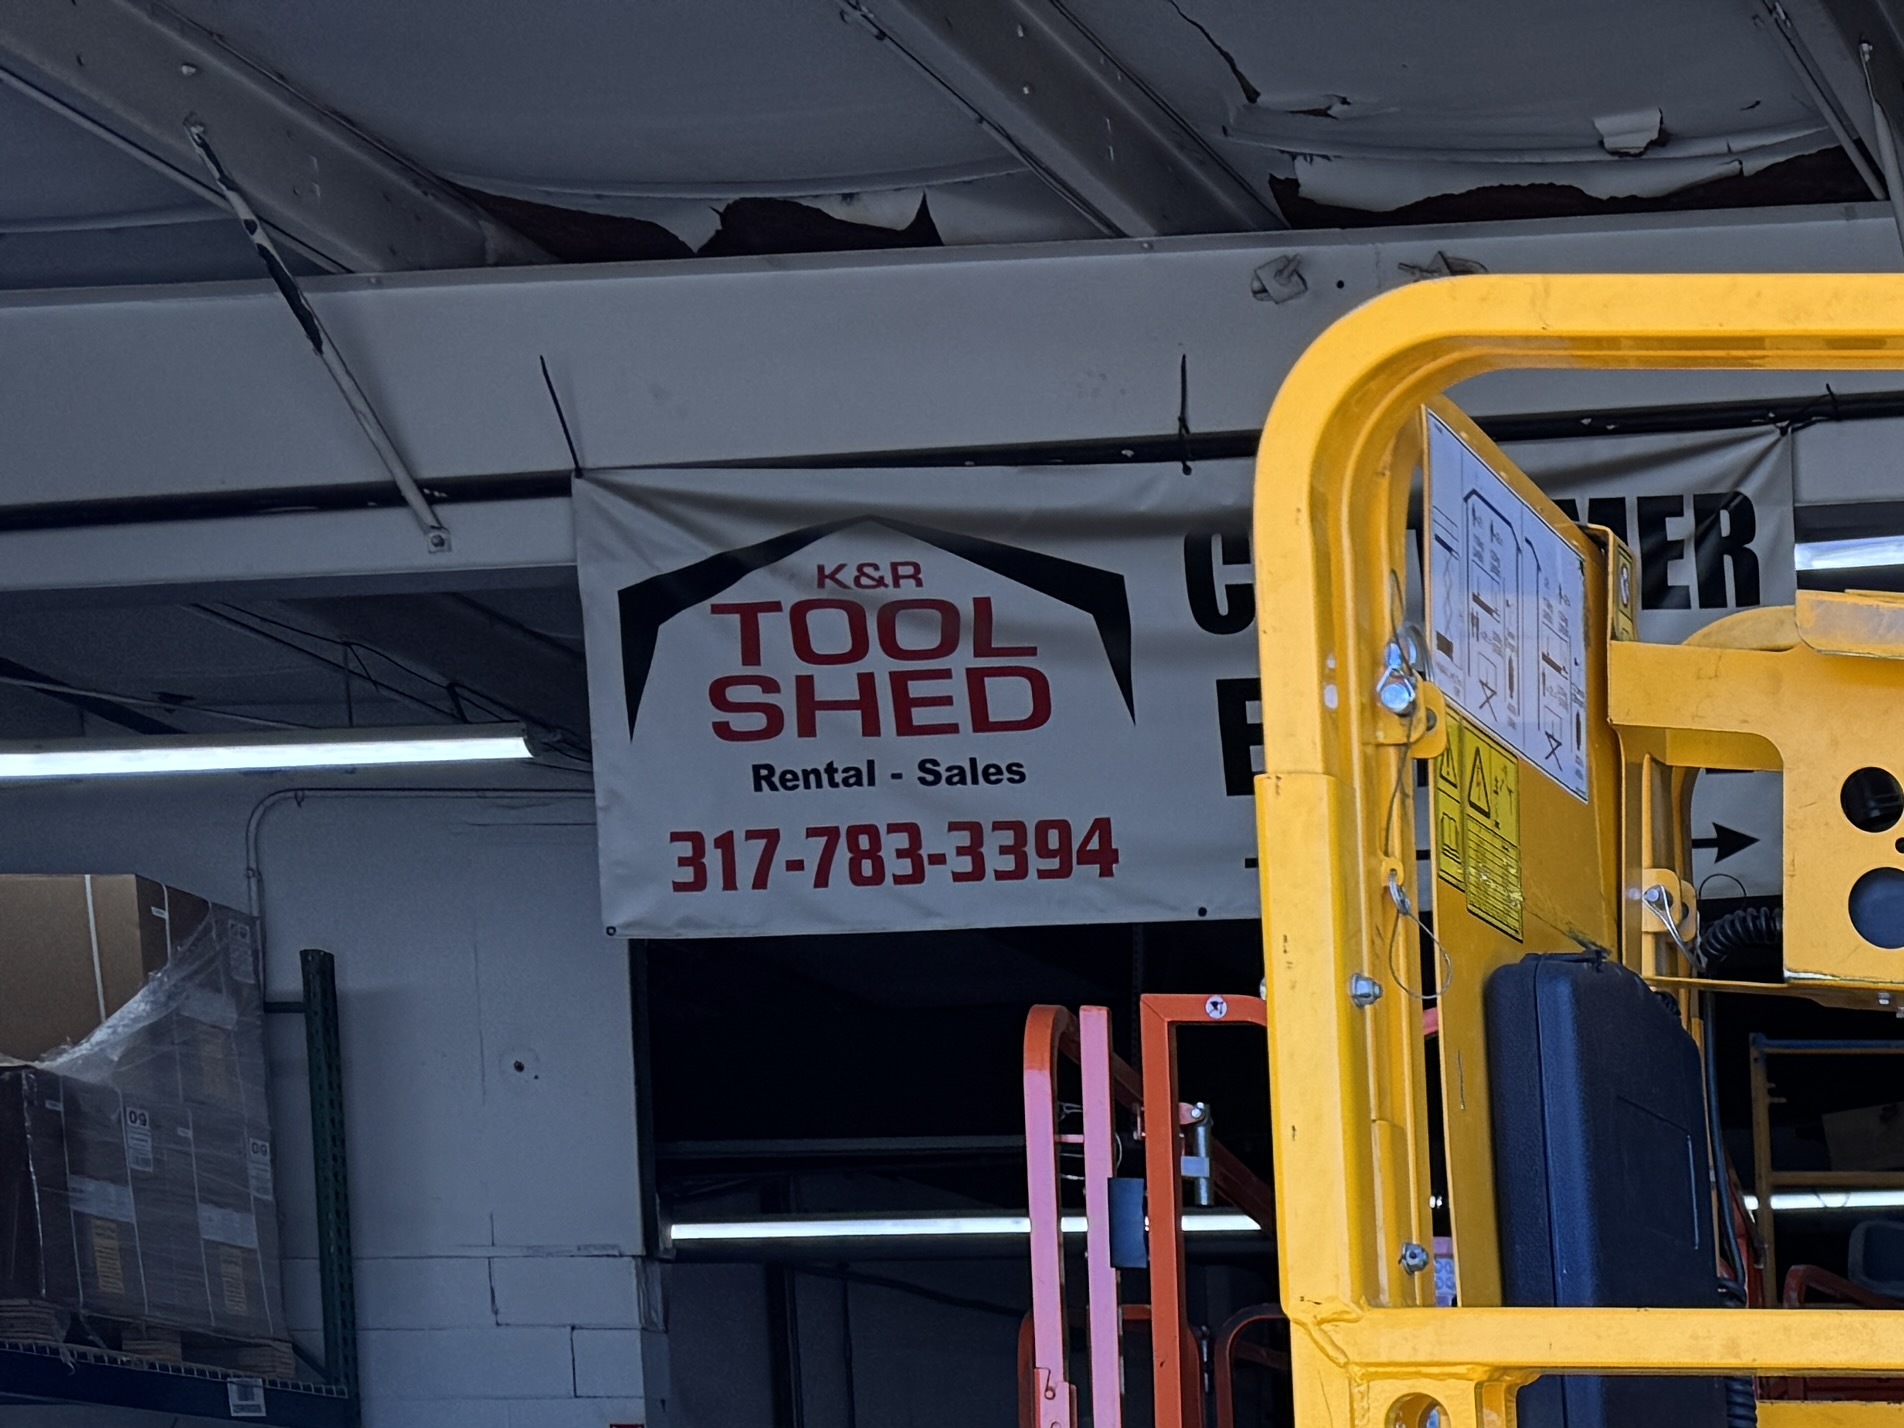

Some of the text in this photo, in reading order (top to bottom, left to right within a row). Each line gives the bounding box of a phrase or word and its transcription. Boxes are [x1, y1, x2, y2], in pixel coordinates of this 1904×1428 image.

[816, 560, 924, 591] K&R
[710, 596, 1039, 667] TOOL
[708, 665, 1052, 743] SHED
[751, 758, 879, 793] Rental
[916, 757, 1028, 787] Sales
[669, 815, 1120, 893] 317-783-3394
